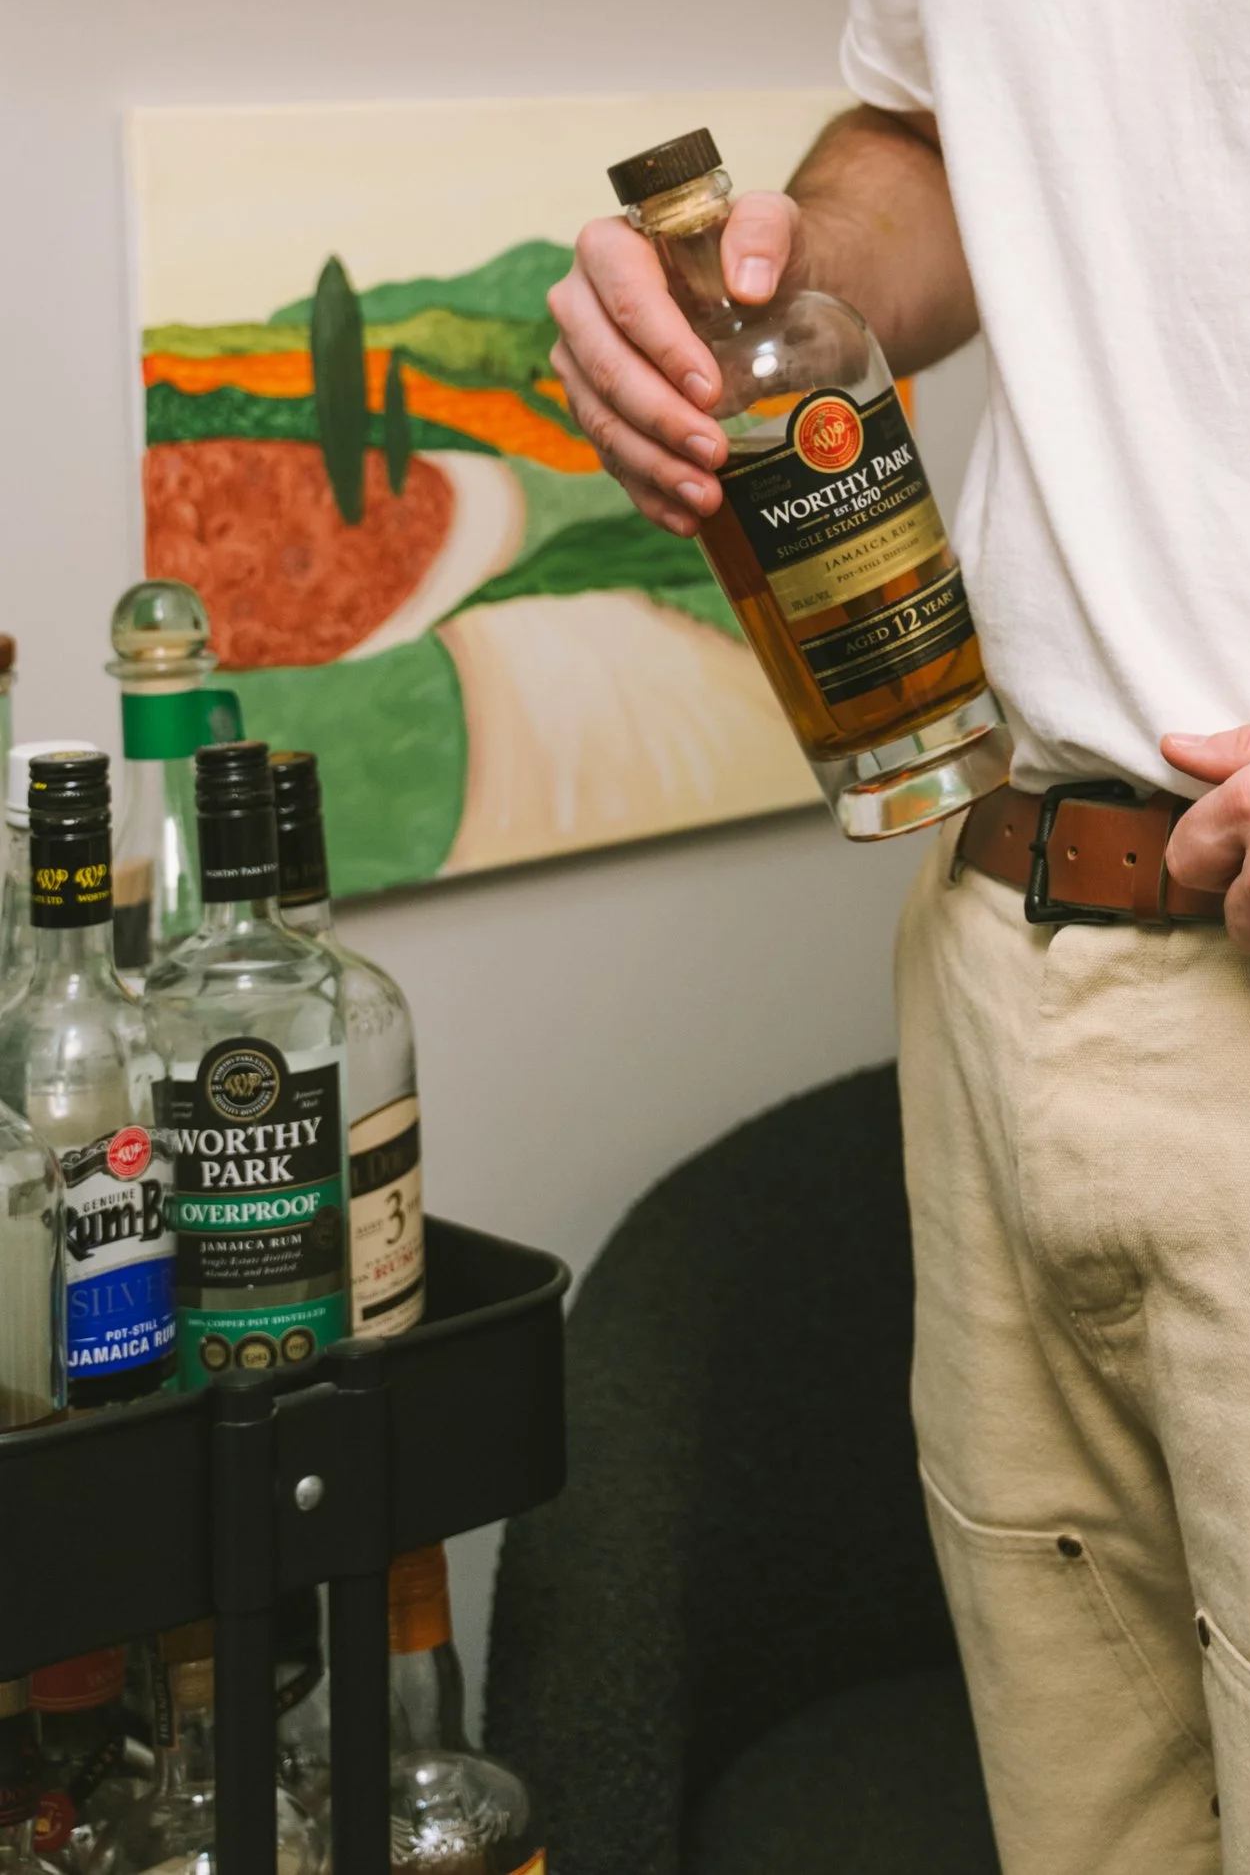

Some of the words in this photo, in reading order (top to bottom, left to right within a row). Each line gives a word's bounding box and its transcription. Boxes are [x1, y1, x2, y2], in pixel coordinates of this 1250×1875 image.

[760, 468, 870, 529] WORTHY
[871, 443, 914, 481] PARK
[851, 486, 882, 511] 1670
[776, 531, 825, 559] SINGLE
[826, 511, 870, 539] ESTATE
[869, 479, 923, 517] COLLECTION
[824, 536, 889, 572] JAMAICA
[891, 519, 918, 539] RUM
[846, 627, 890, 655] AGED
[892, 607, 922, 638] 12
[920, 589, 954, 617] YEARS
[76, 889, 111, 903] WORTH
[173, 1116, 322, 1157] WORTHY
[200, 1154, 295, 1189] PARK
[82, 1187, 137, 1214] GENUINE
[180, 1191, 321, 1225] OVERPROOF
[385, 1188, 407, 1245] 3
[200, 1238, 265, 1254] JAMAICA
[267, 1233, 302, 1249] RUM
[243, 1267, 262, 1278] and
[70, 1267, 172, 1319] SILVER
[105, 1318, 158, 1342] POT-STILL
[246, 1316, 269, 1327] POT
[68, 1336, 151, 1367] JAMAICA
